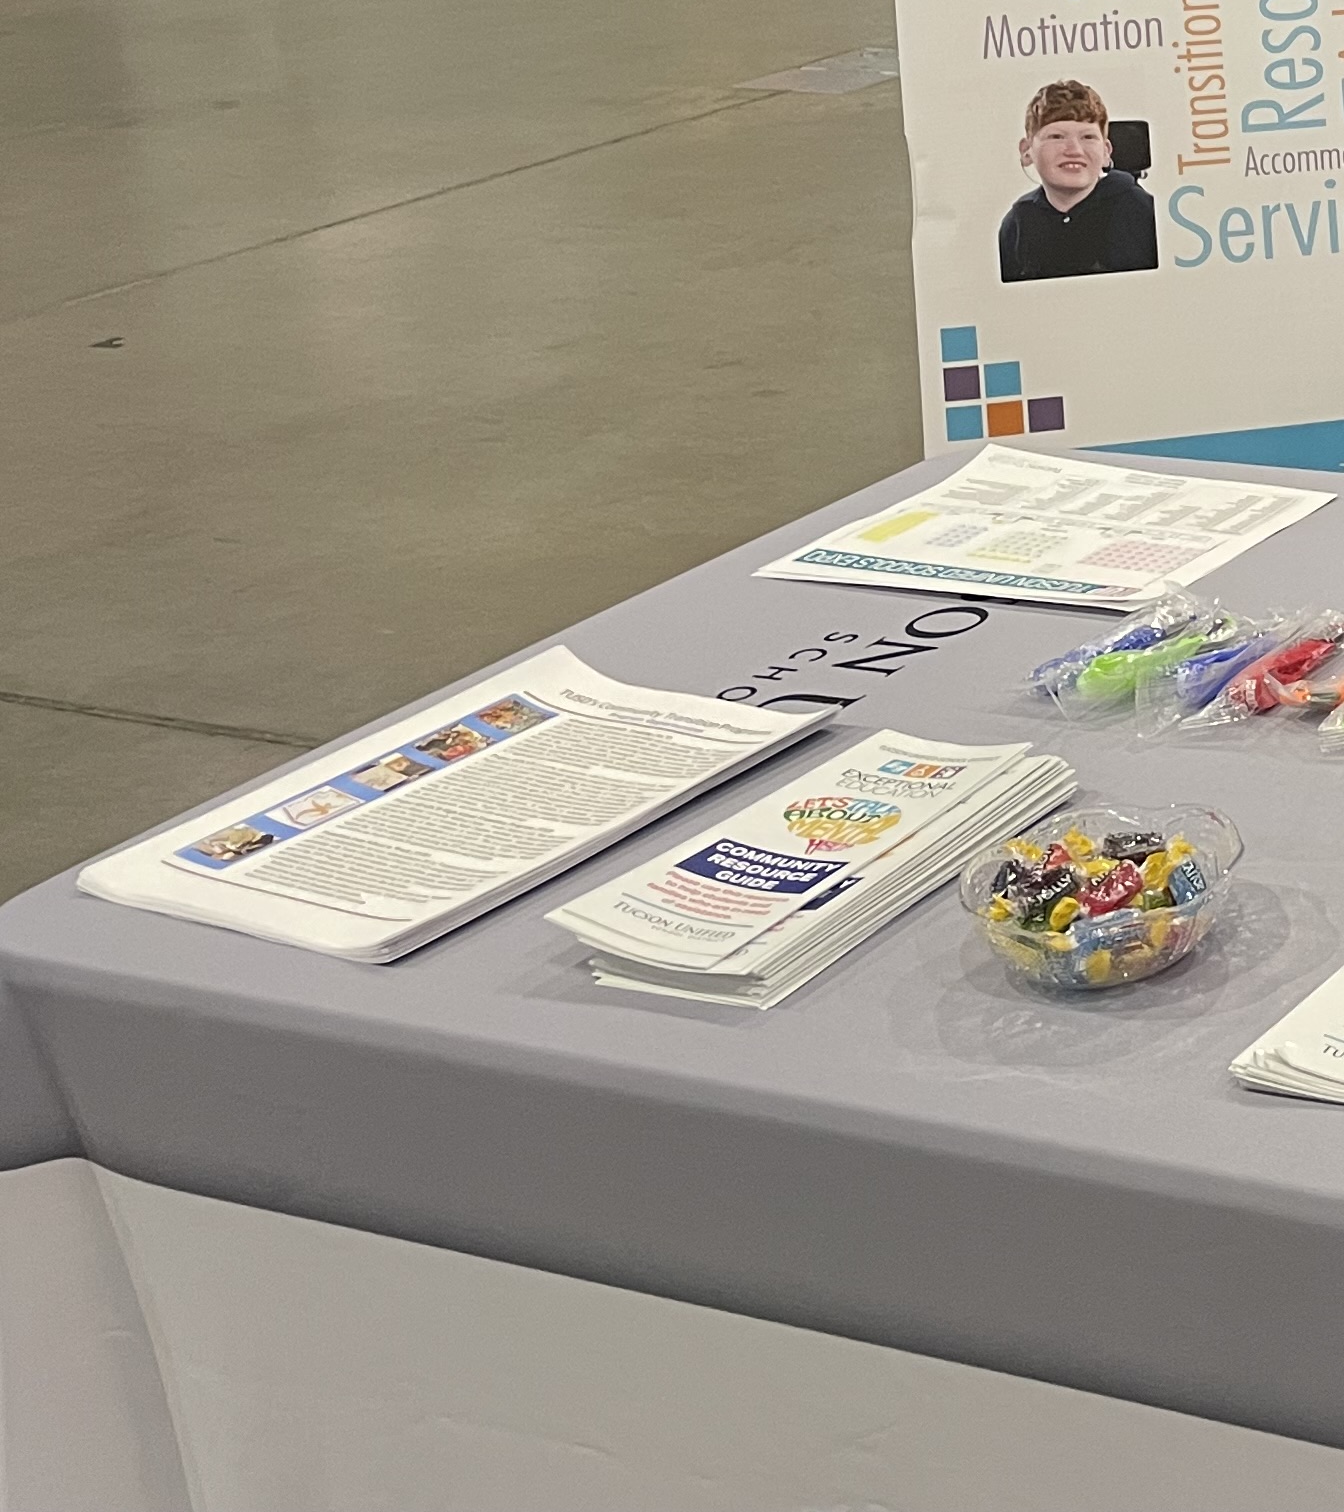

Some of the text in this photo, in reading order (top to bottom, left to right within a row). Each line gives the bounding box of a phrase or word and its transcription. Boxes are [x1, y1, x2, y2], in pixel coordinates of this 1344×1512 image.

[982, 8, 1165, 61] Motivation
[840, 768, 957, 791] EXCEPTIONAL
[783, 806, 881, 824] ABOUT
[786, 796, 853, 810] LET'S
[706, 853, 820, 883] RESOURCE
[715, 842, 842, 873] COMMUNITY
[715, 870, 780, 891] GUIDE
[1034, 872, 1073, 906] JOLLY
[613, 900, 674, 928] TUCSON
[675, 921, 736, 939] UNIFIED
